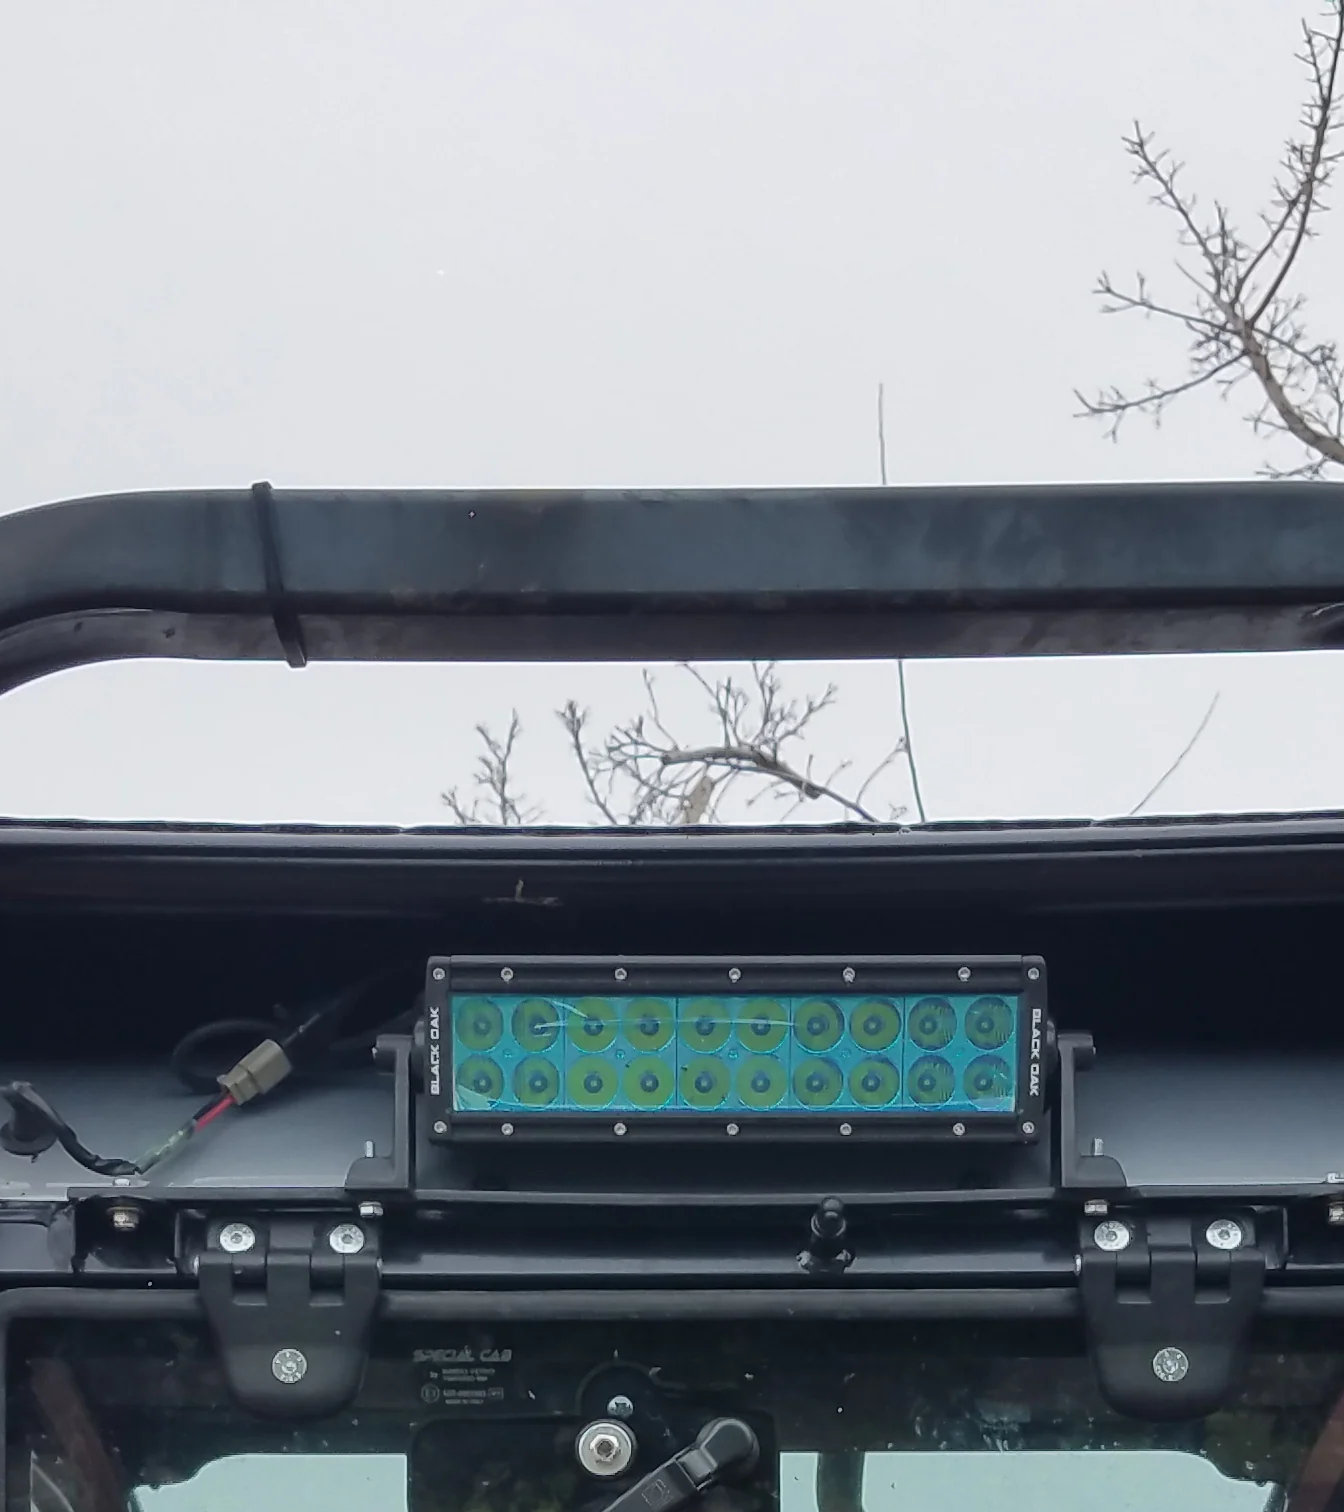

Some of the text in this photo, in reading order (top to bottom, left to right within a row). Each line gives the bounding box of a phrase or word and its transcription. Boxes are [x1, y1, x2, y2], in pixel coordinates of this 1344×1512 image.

[430, 1006, 440, 1096] BLACK OAK
[1029, 1008, 1042, 1096] BLACK OAK
